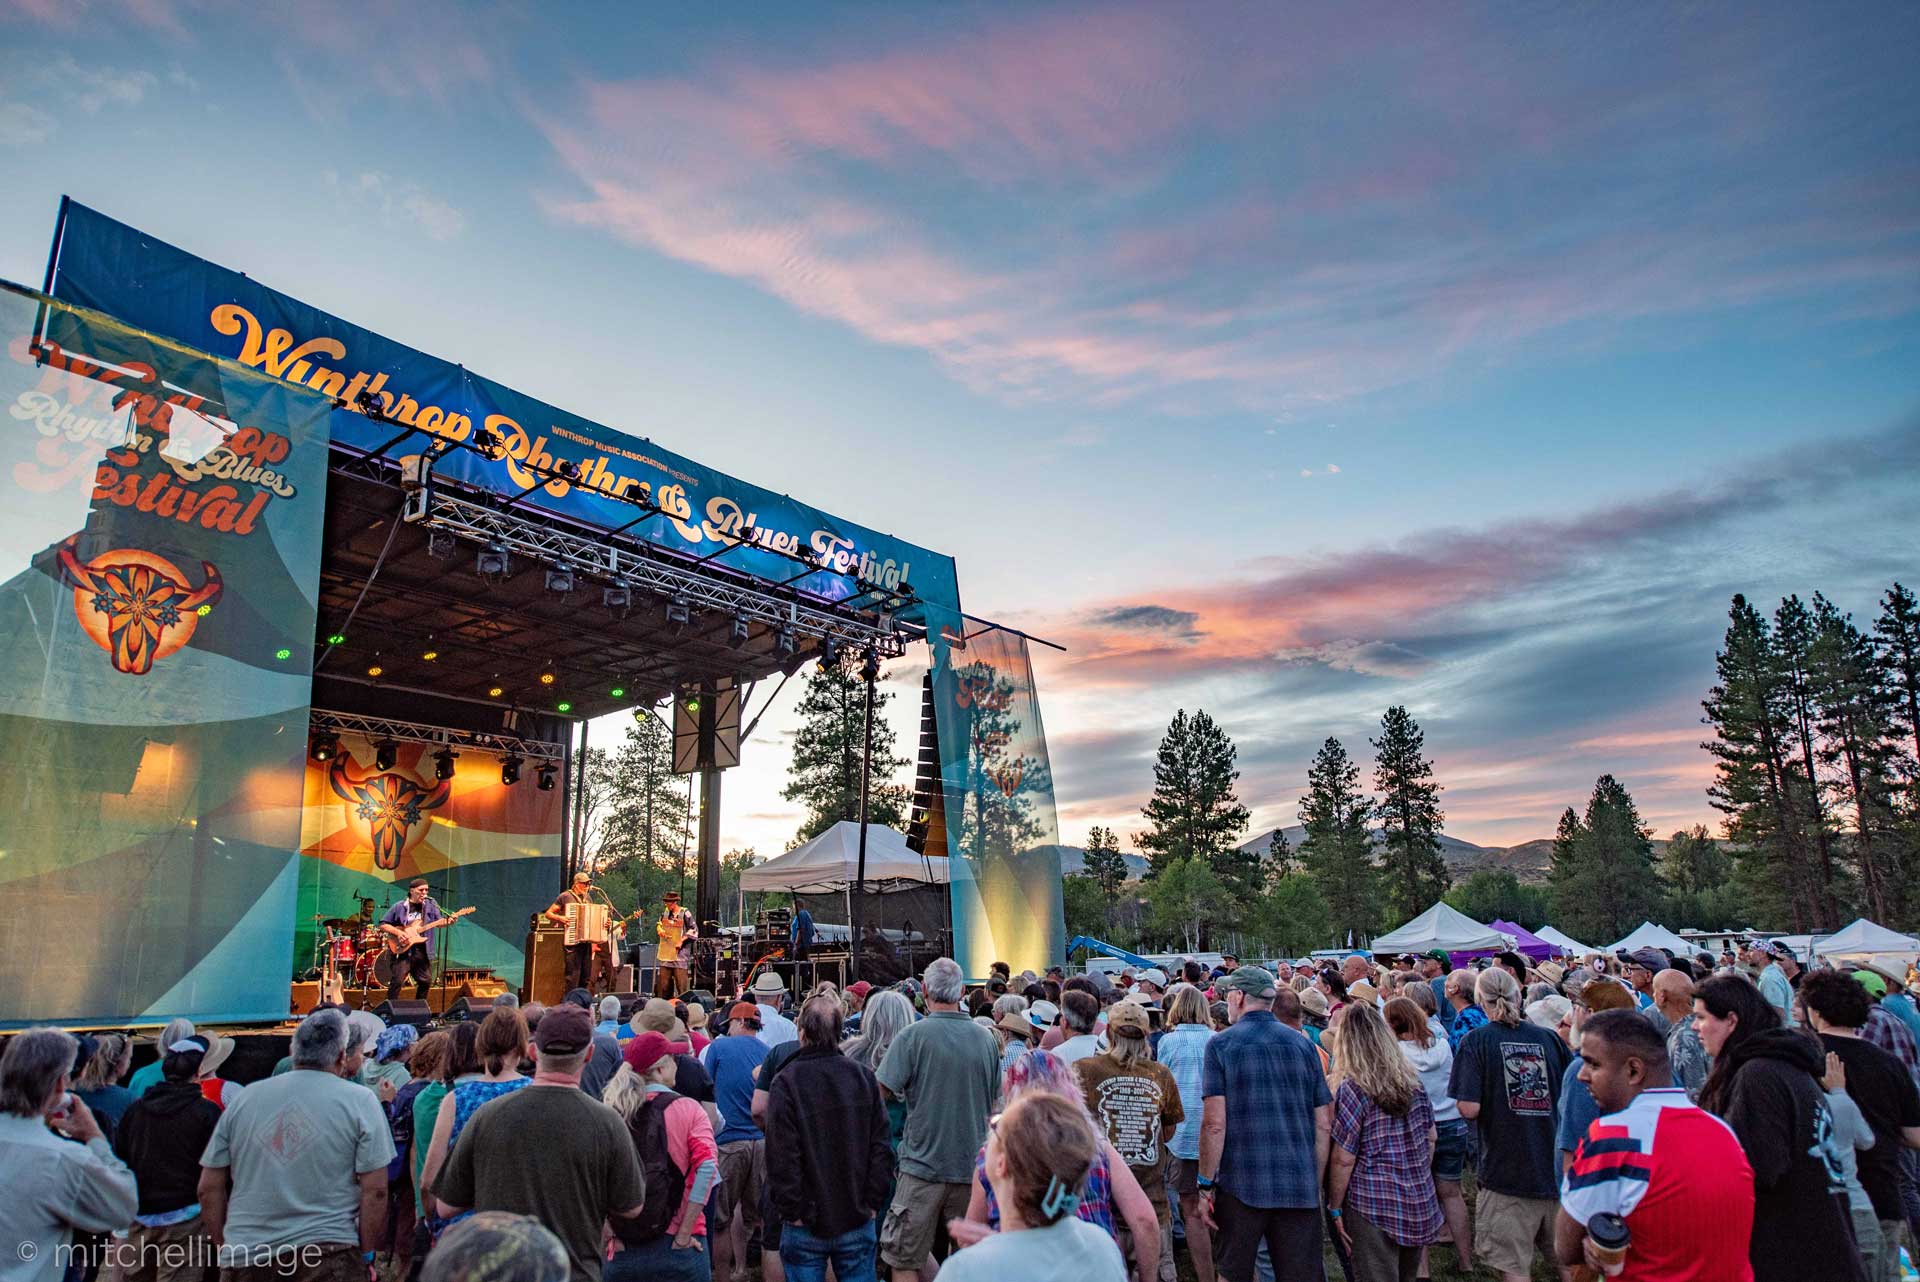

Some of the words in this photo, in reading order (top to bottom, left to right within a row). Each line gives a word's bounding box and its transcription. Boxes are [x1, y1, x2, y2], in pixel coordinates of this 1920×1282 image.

[197, 447, 295, 497] Blues
[210, 304, 472, 450] Winthrop
[702, 496, 800, 558] Blues
[810, 530, 910, 591] Festival
[552, 425, 594, 447] WINTHROP
[595, 441, 621, 456] MUSIC
[621, 449, 669, 474] ASSOCIATION
